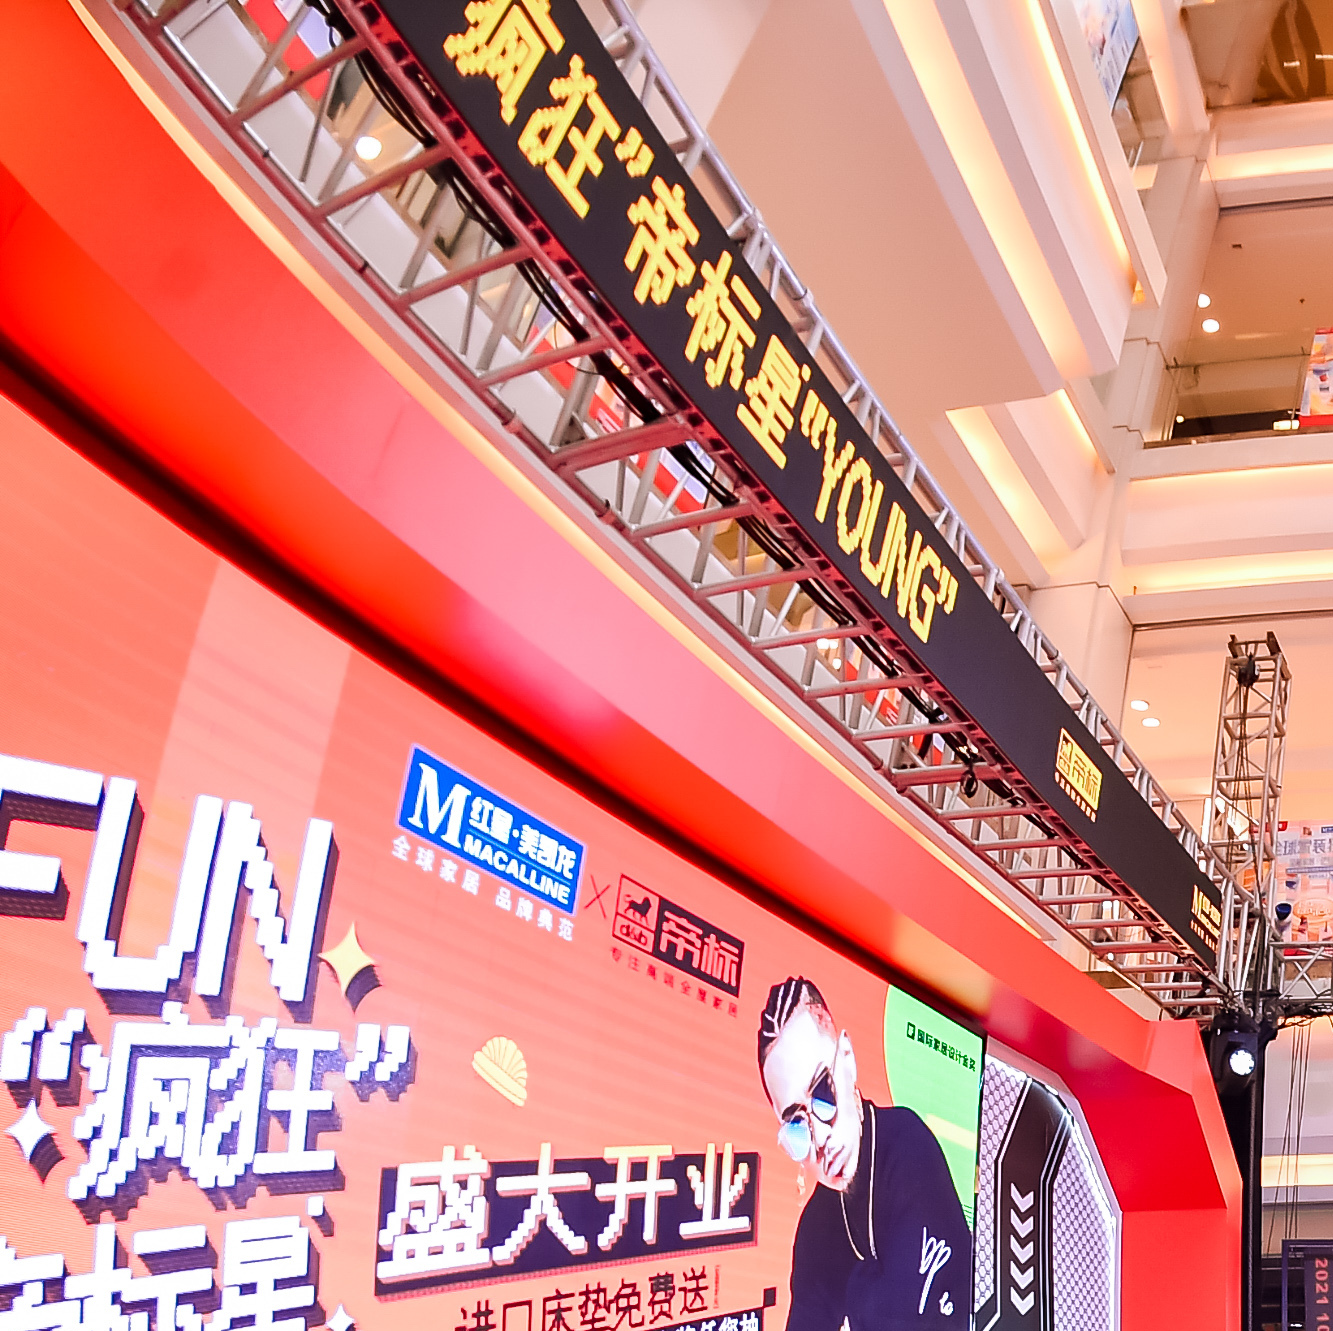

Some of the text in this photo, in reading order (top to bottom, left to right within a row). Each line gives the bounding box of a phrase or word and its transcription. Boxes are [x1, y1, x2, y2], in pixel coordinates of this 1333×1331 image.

[408, 762, 472, 849] M
[468, 796, 577, 879] 红星·美凯龙
[391, 834, 575, 941] 全球家居 品牌典范
[463, 833, 571, 905] MACALLINE
[658, 910, 740, 987] 帝标
[376, 1142, 752, 1281] 盛大开业
[1314, 1258, 1330, 1305] 2021
